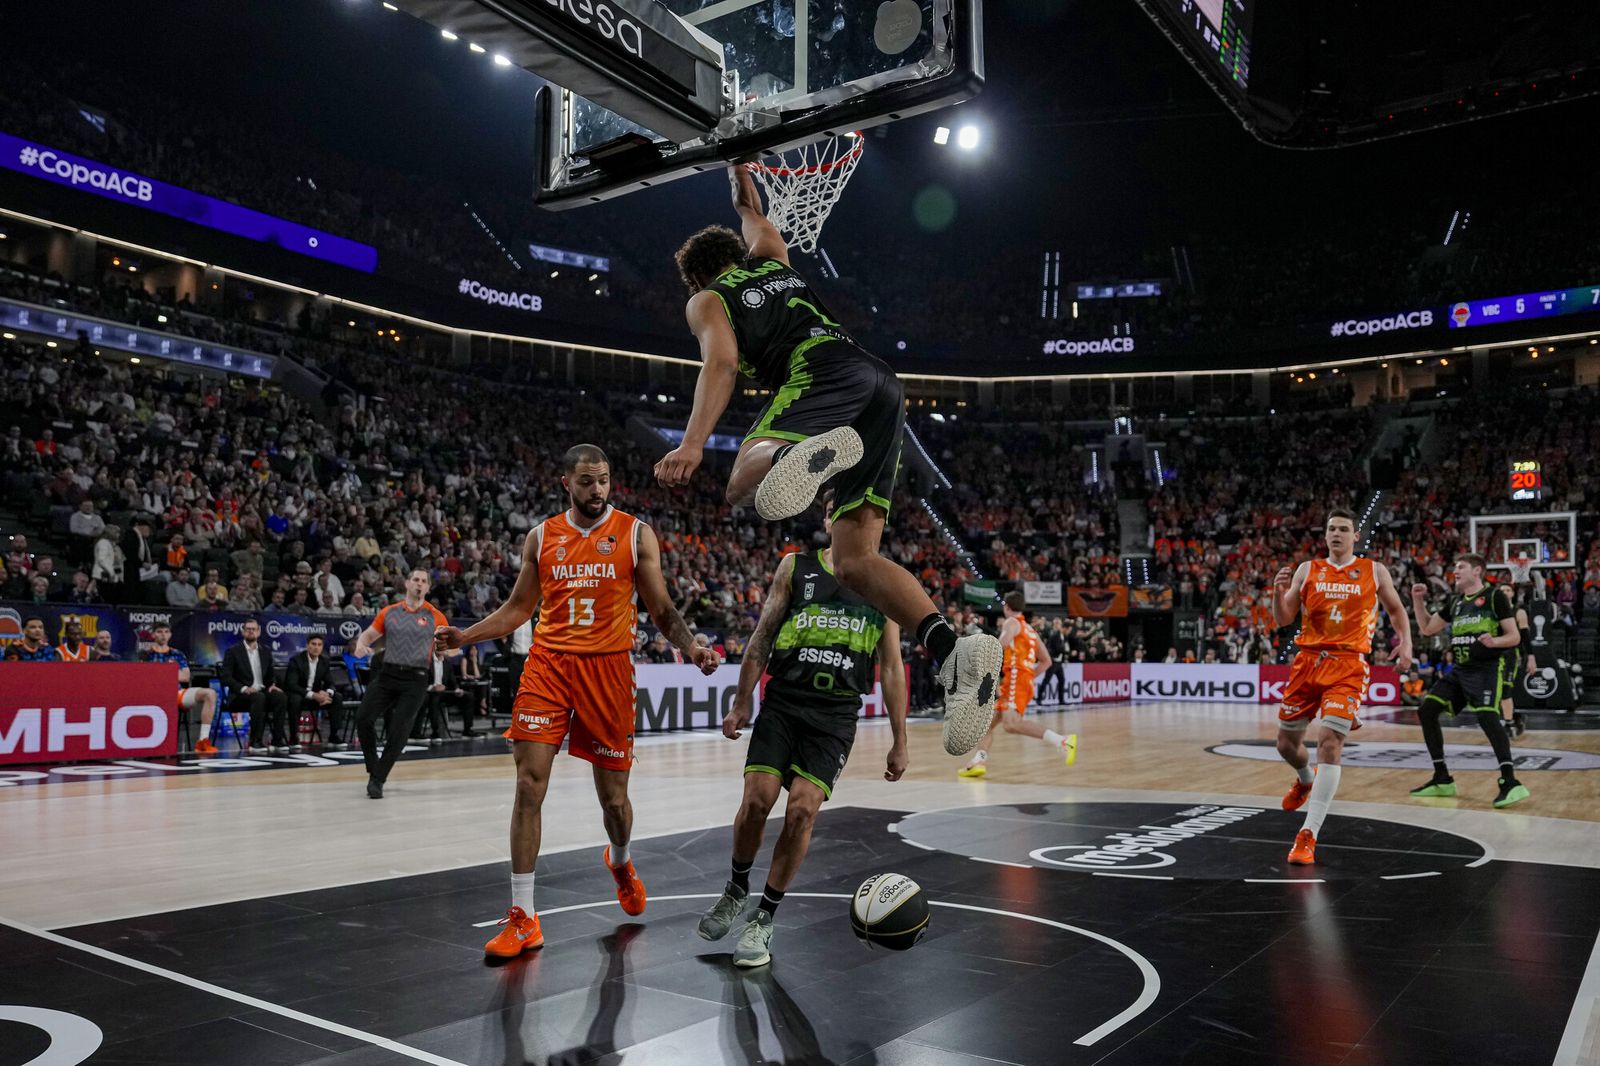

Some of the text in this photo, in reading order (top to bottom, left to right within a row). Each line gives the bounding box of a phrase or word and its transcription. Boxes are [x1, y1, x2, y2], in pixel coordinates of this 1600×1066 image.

[19, 146, 153, 202] #CopaACB
[458, 278, 543, 312] #CopaACB
[1331, 311, 1433, 336] #CopaACB
[1043, 337, 1134, 356] #CopaACB
[1511, 472, 1536, 488] 20
[552, 563, 616, 580] VALENCIA
[567, 579, 600, 588] BASKET
[1316, 583, 1361, 595] VALENCIA
[568, 598, 596, 625] 13
[1329, 605, 1343, 624] 4
[268, 622, 328, 635] mediolanum
[797, 612, 867, 634] Bressol
[1083, 679, 1131, 698] KUMHO
[1136, 680, 1255, 698] KUMHO
[518, 713, 551, 725] PULEVA
[879, 884, 900, 903] Copa
